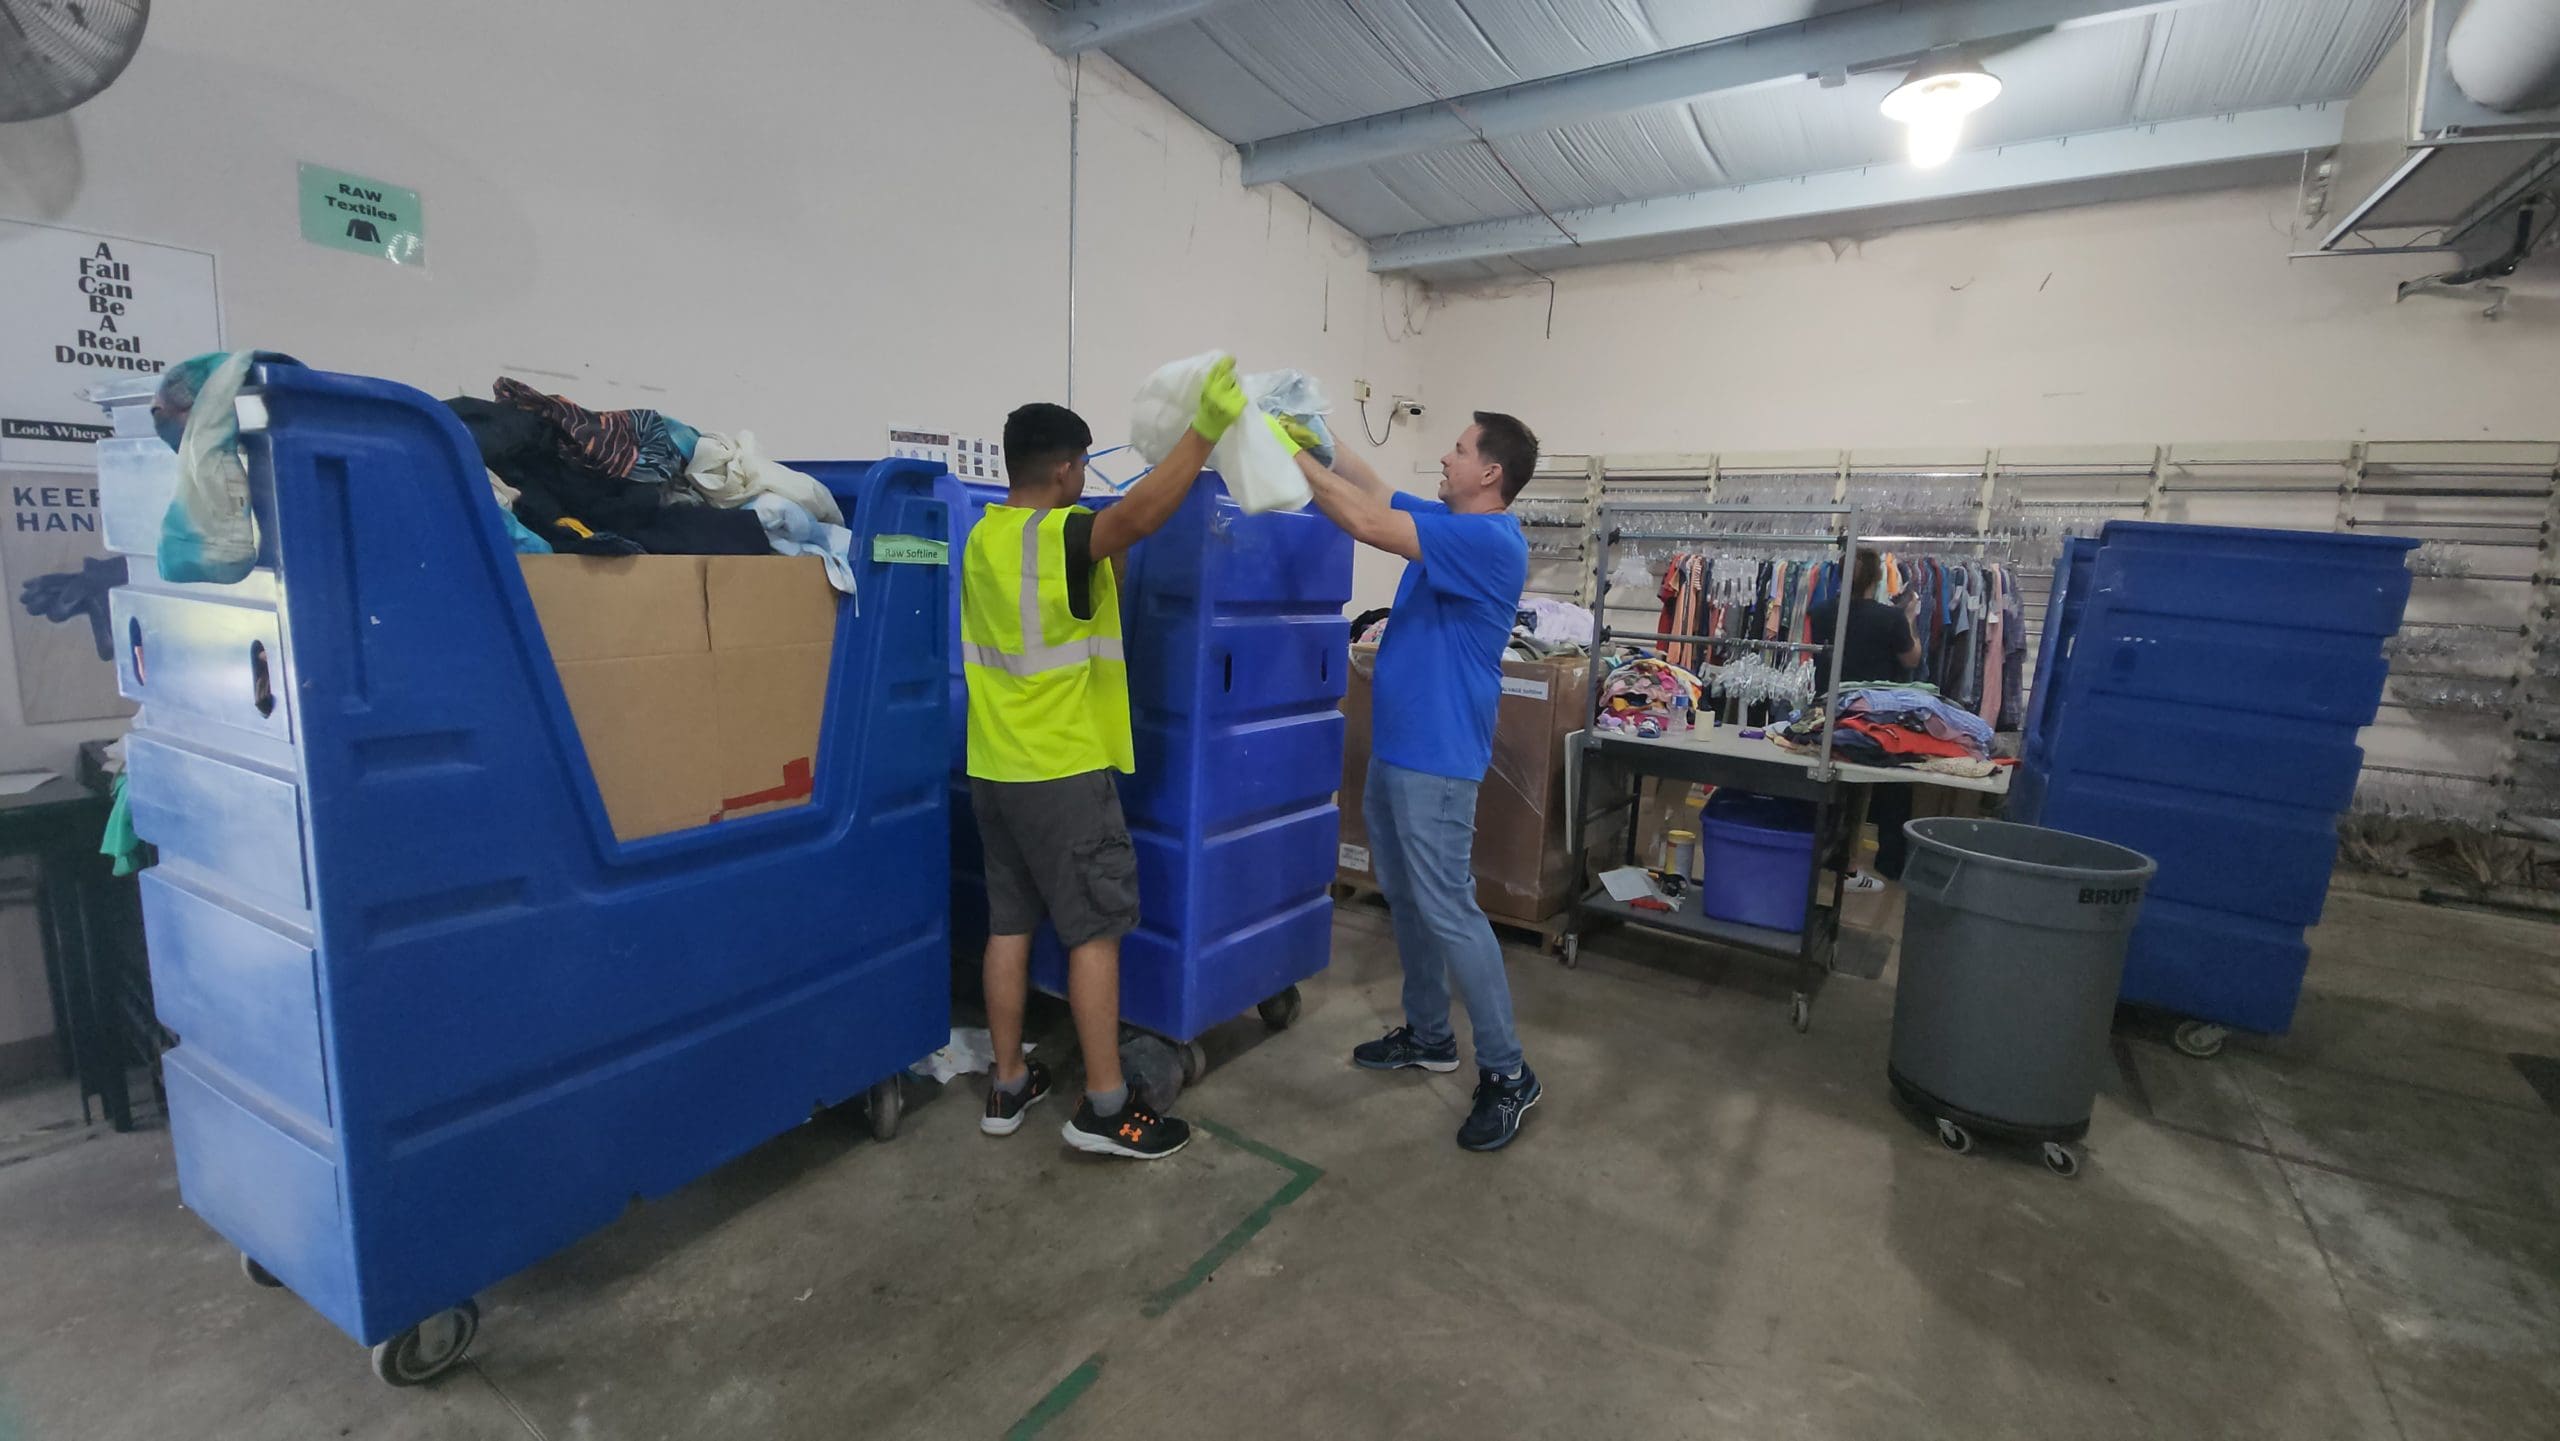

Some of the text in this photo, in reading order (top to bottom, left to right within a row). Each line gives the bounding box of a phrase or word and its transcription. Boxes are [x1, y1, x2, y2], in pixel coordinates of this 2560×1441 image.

[338, 183, 382, 203] RAW
[324, 194, 397, 222] Textiles
[95, 241, 112, 261] A
[79, 257, 130, 281] Fall
[78, 275, 133, 300] Can
[88, 294, 125, 316] Be
[99, 314, 117, 333] A
[77, 329, 141, 353] Real
[55, 345, 165, 373] Downer
[9, 422, 50, 436] Look
[52, 424, 106, 440] Where
[15, 512, 102, 532] HAN
[885, 548, 938, 559] Raw Softline
[2078, 887, 2139, 905] BRUTE
